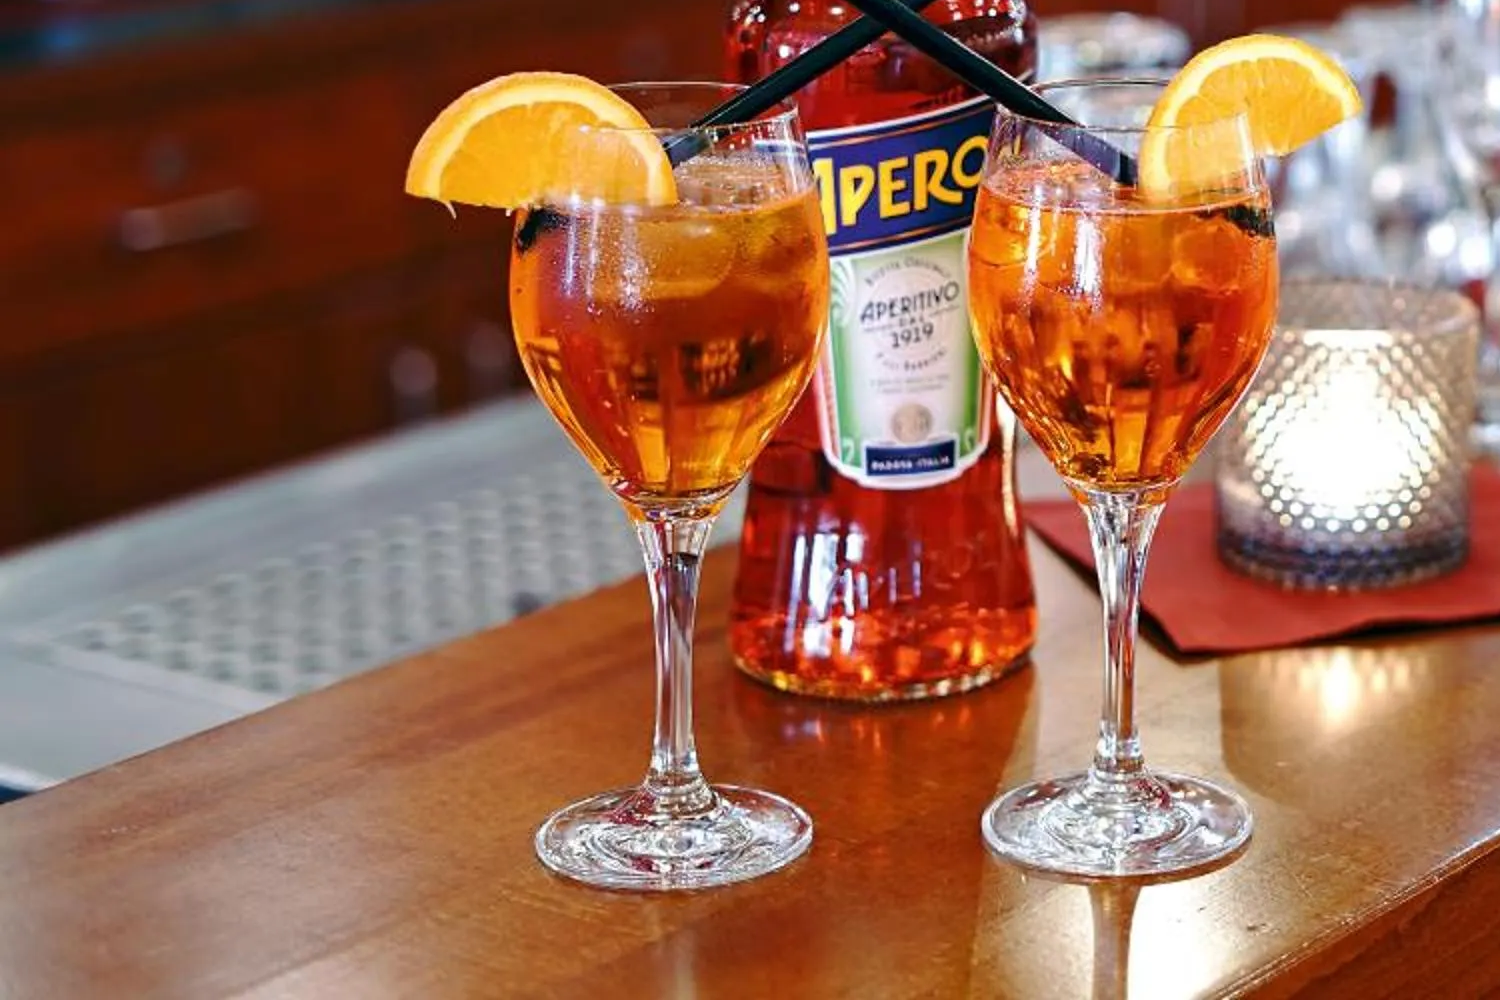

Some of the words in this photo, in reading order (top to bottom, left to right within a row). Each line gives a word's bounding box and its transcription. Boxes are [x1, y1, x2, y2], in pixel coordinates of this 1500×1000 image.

[812, 135, 989, 235] APERO
[860, 281, 960, 322] APERITIVO
[891, 322, 934, 348] 1919
